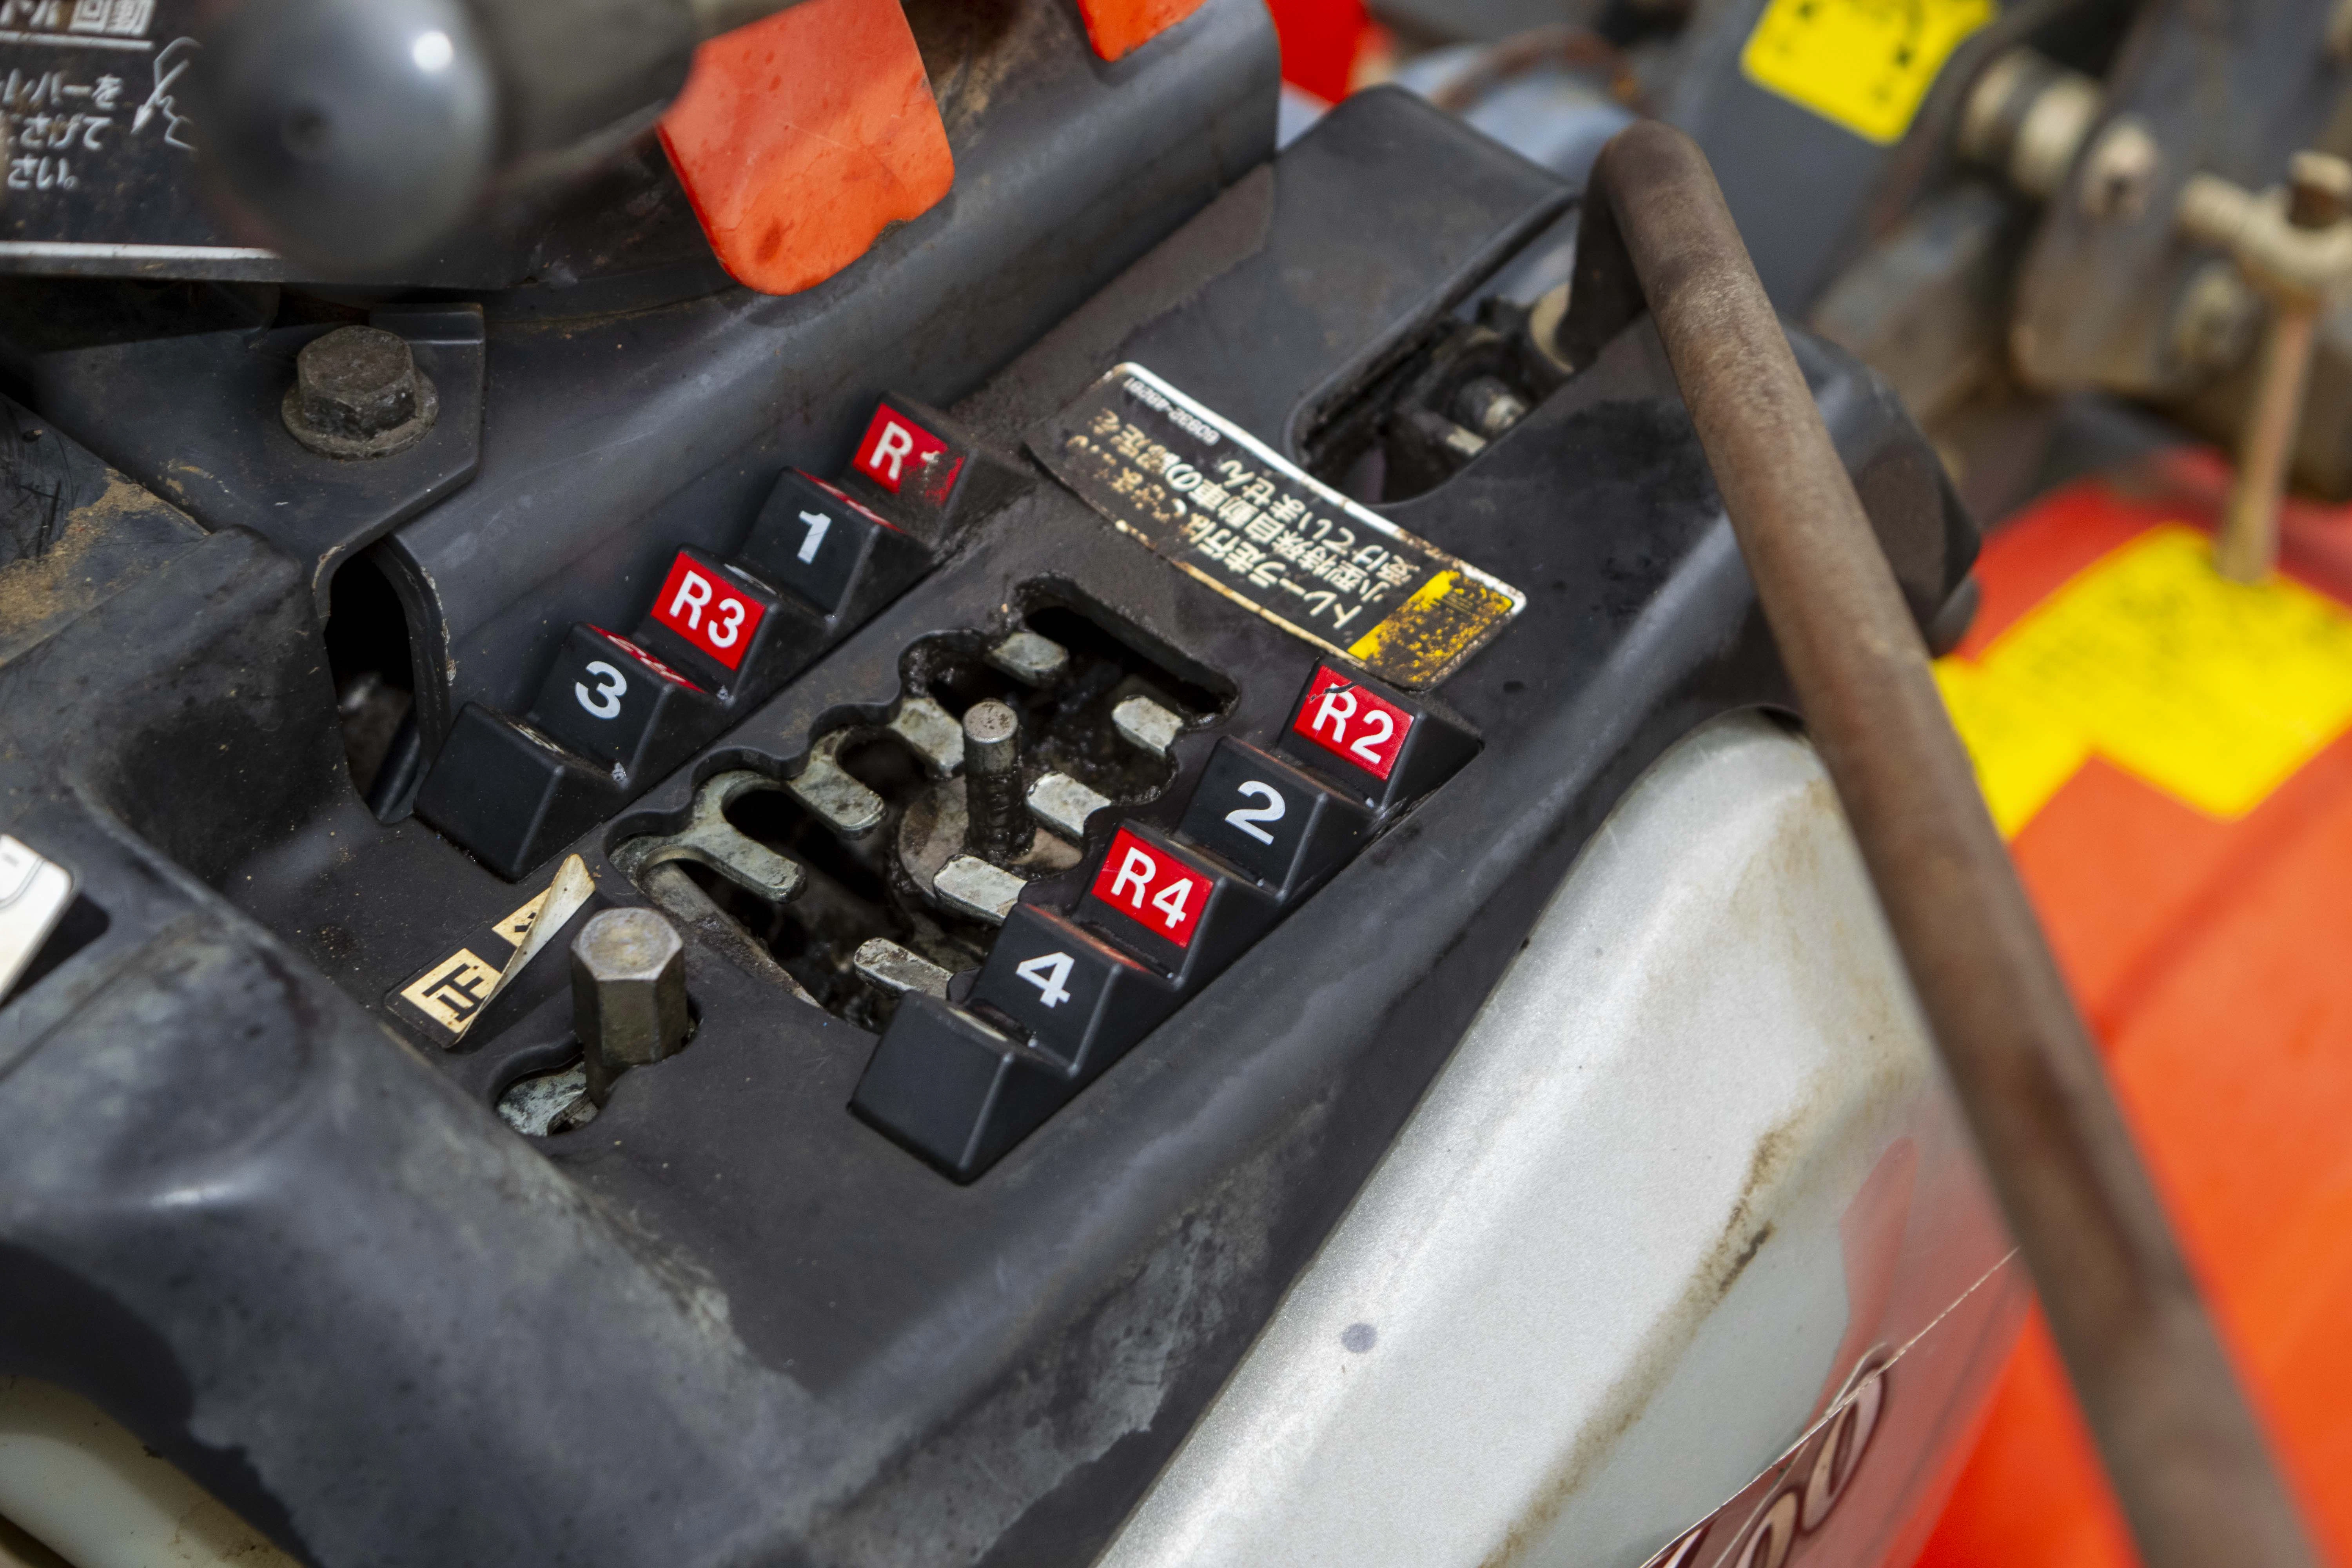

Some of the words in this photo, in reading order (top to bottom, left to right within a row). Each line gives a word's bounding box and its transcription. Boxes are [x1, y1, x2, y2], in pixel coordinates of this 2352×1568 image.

[797, 510, 831, 564] 1
[1218, 460, 1421, 586] 受けていません
[669, 570, 745, 648] R3
[575, 661, 627, 719] 3
[1312, 683, 1394, 764] R2
[1225, 780, 1285, 845] 2
[1111, 846, 1194, 929] R4
[1015, 951, 1075, 1008] 4
